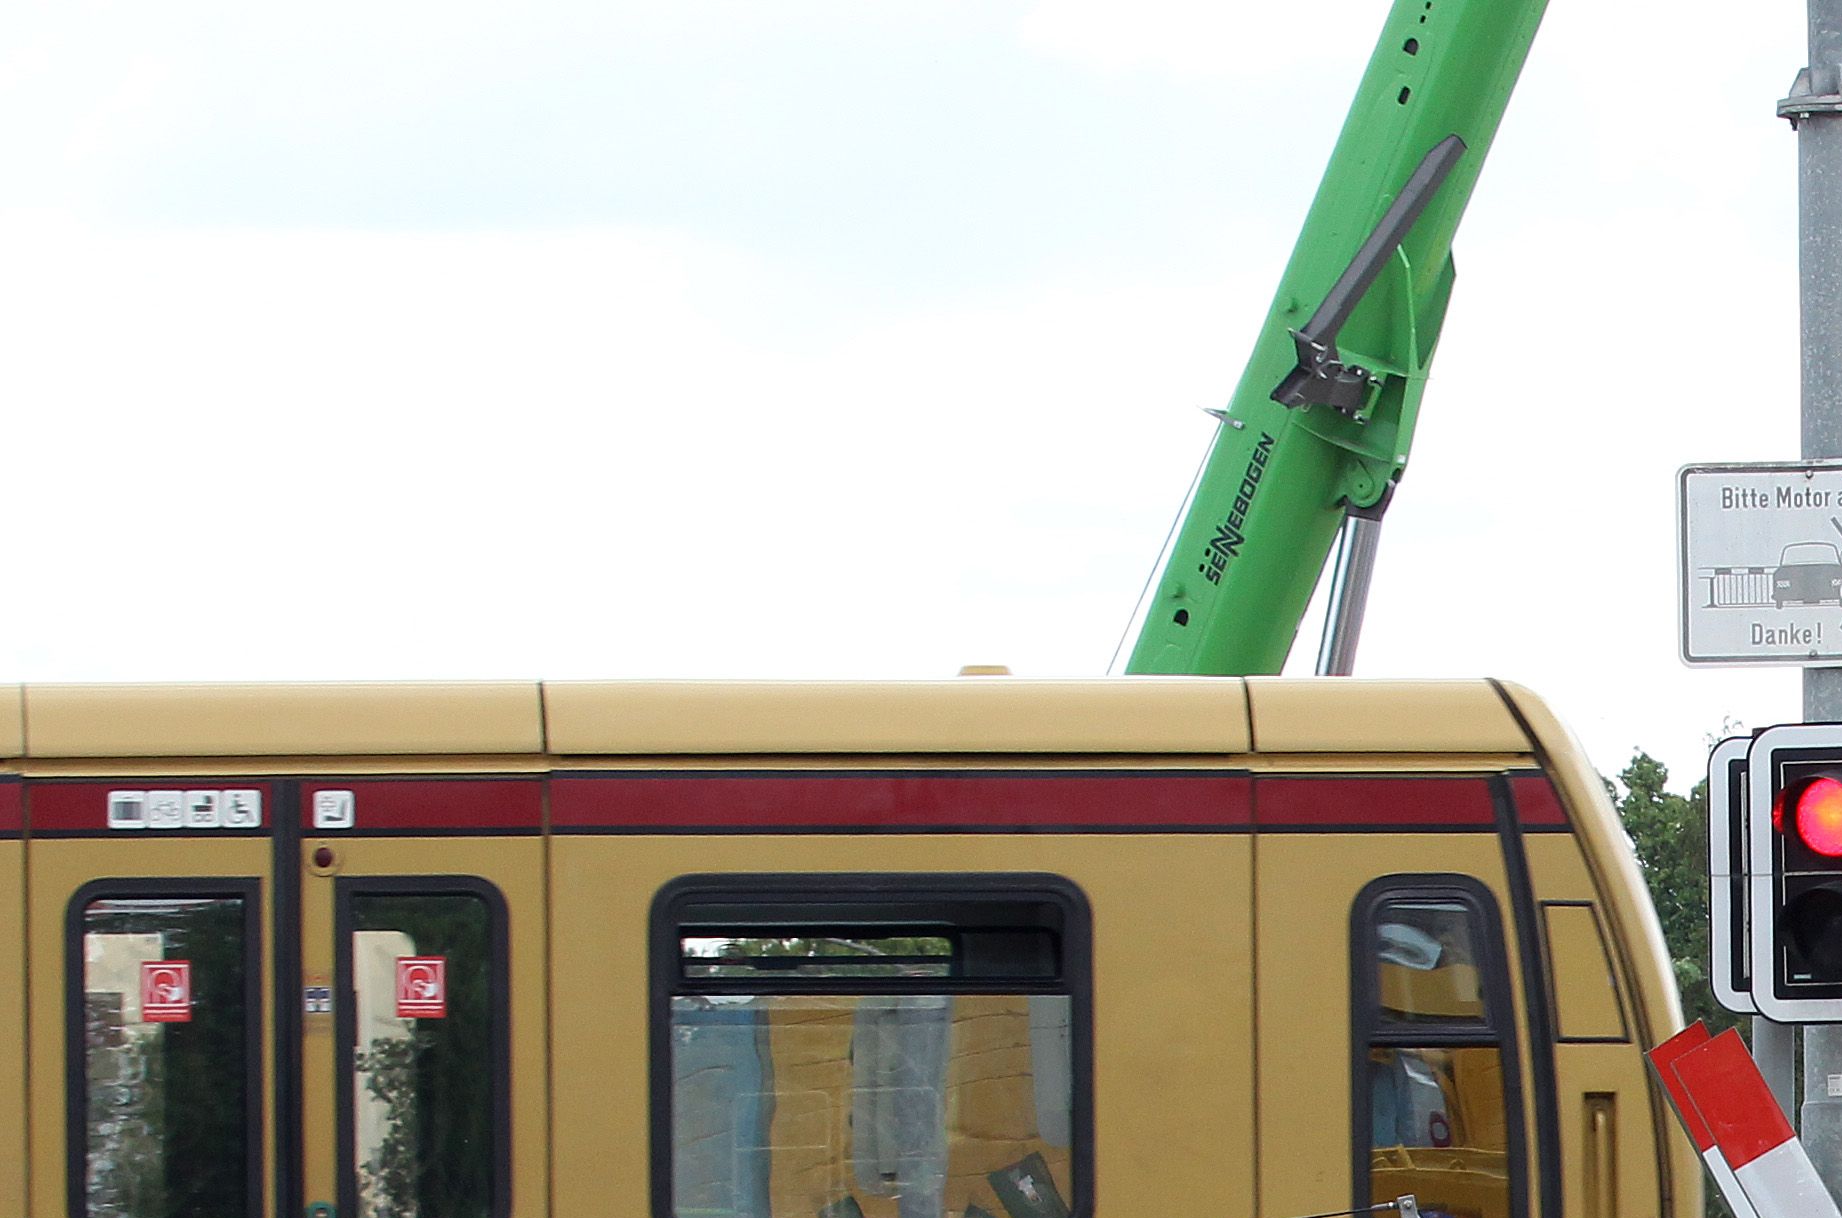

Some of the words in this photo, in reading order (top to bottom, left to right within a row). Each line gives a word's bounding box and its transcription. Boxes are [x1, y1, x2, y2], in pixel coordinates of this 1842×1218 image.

[1205, 431, 1275, 587] SENNEBOGEN
[1721, 486, 1769, 509] Bitte
[1776, 486, 1831, 508] Motor
